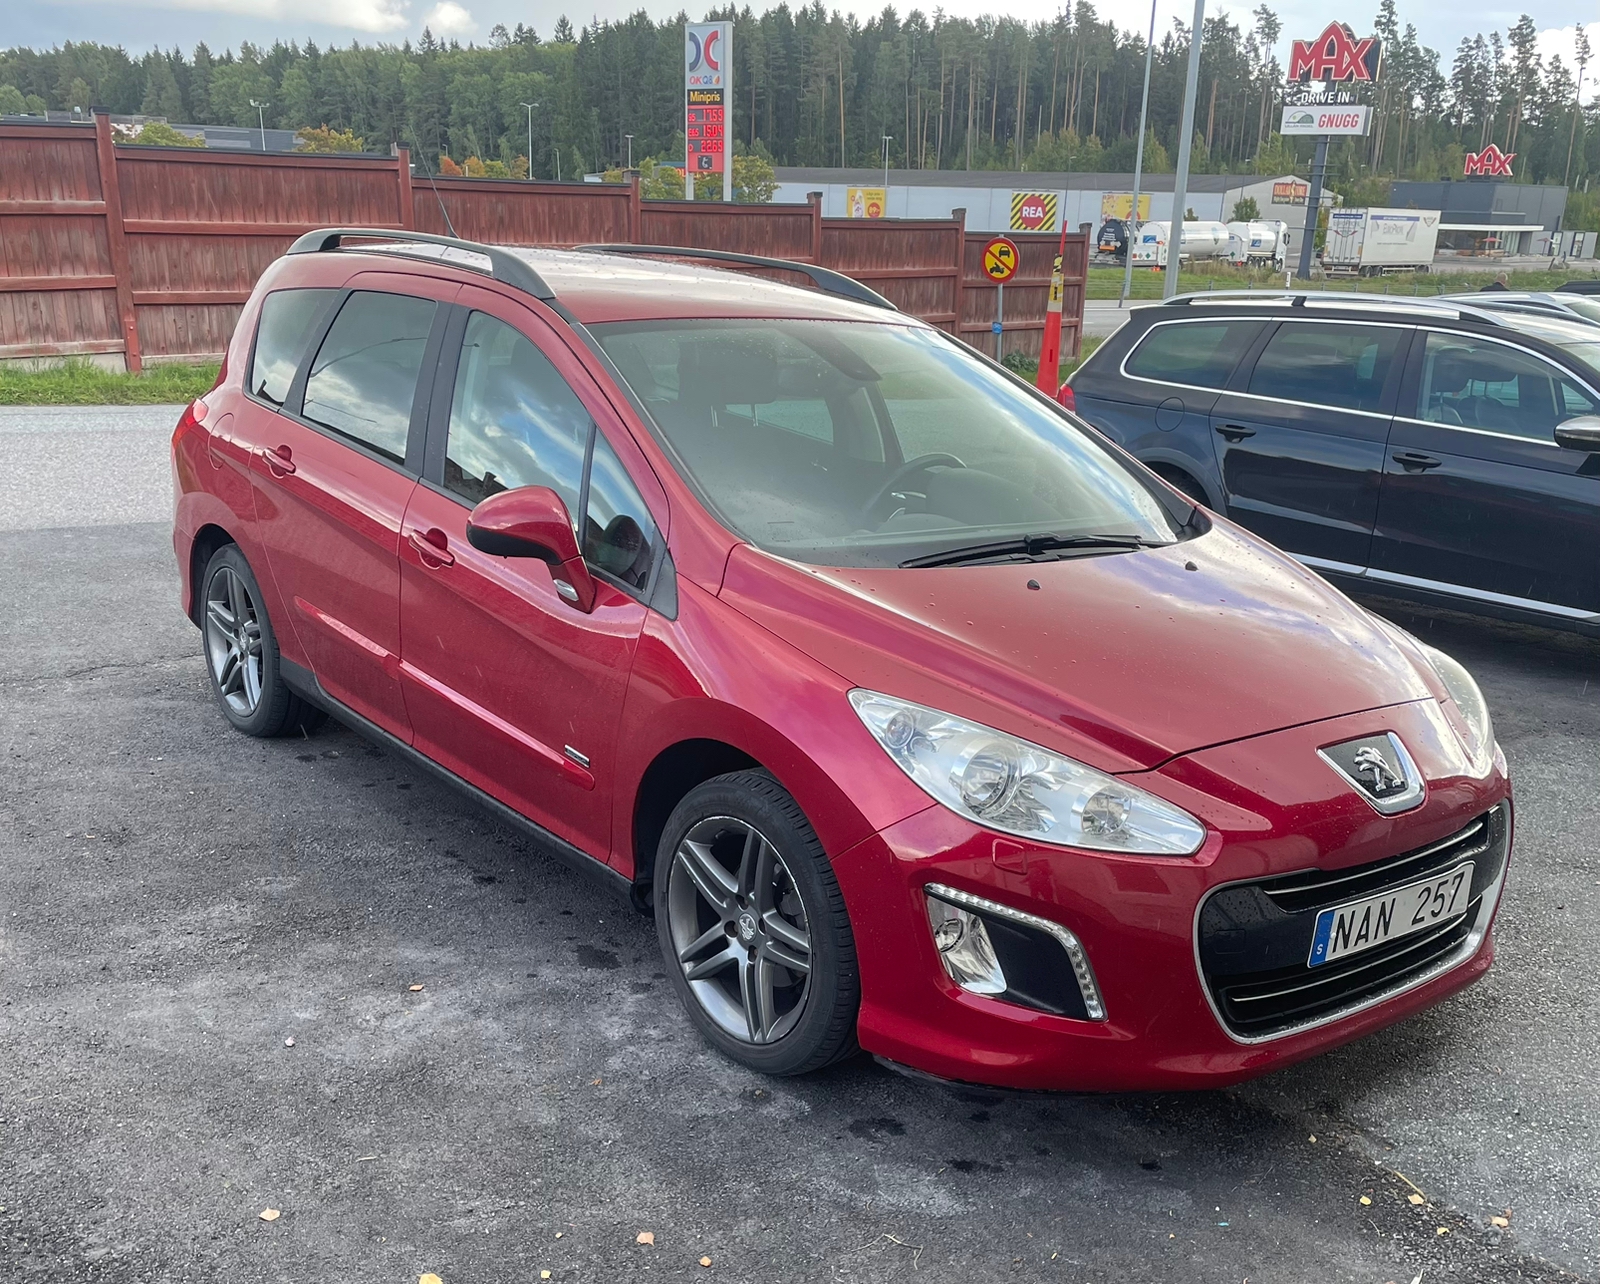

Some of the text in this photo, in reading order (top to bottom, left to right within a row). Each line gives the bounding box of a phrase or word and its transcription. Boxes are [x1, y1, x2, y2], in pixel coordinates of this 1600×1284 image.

[1288, 20, 1375, 81] MAX
[689, 75, 713, 85] OKQ8
[690, 91, 721, 104] Minipris
[1301, 91, 1351, 104] DRIVE IN
[1318, 113, 1360, 128] GNUGG
[1464, 143, 1517, 176] MAX
[1022, 206, 1044, 218] REA
[1332, 871, 1465, 953] NAN 257
[1316, 943, 1324, 955] S
